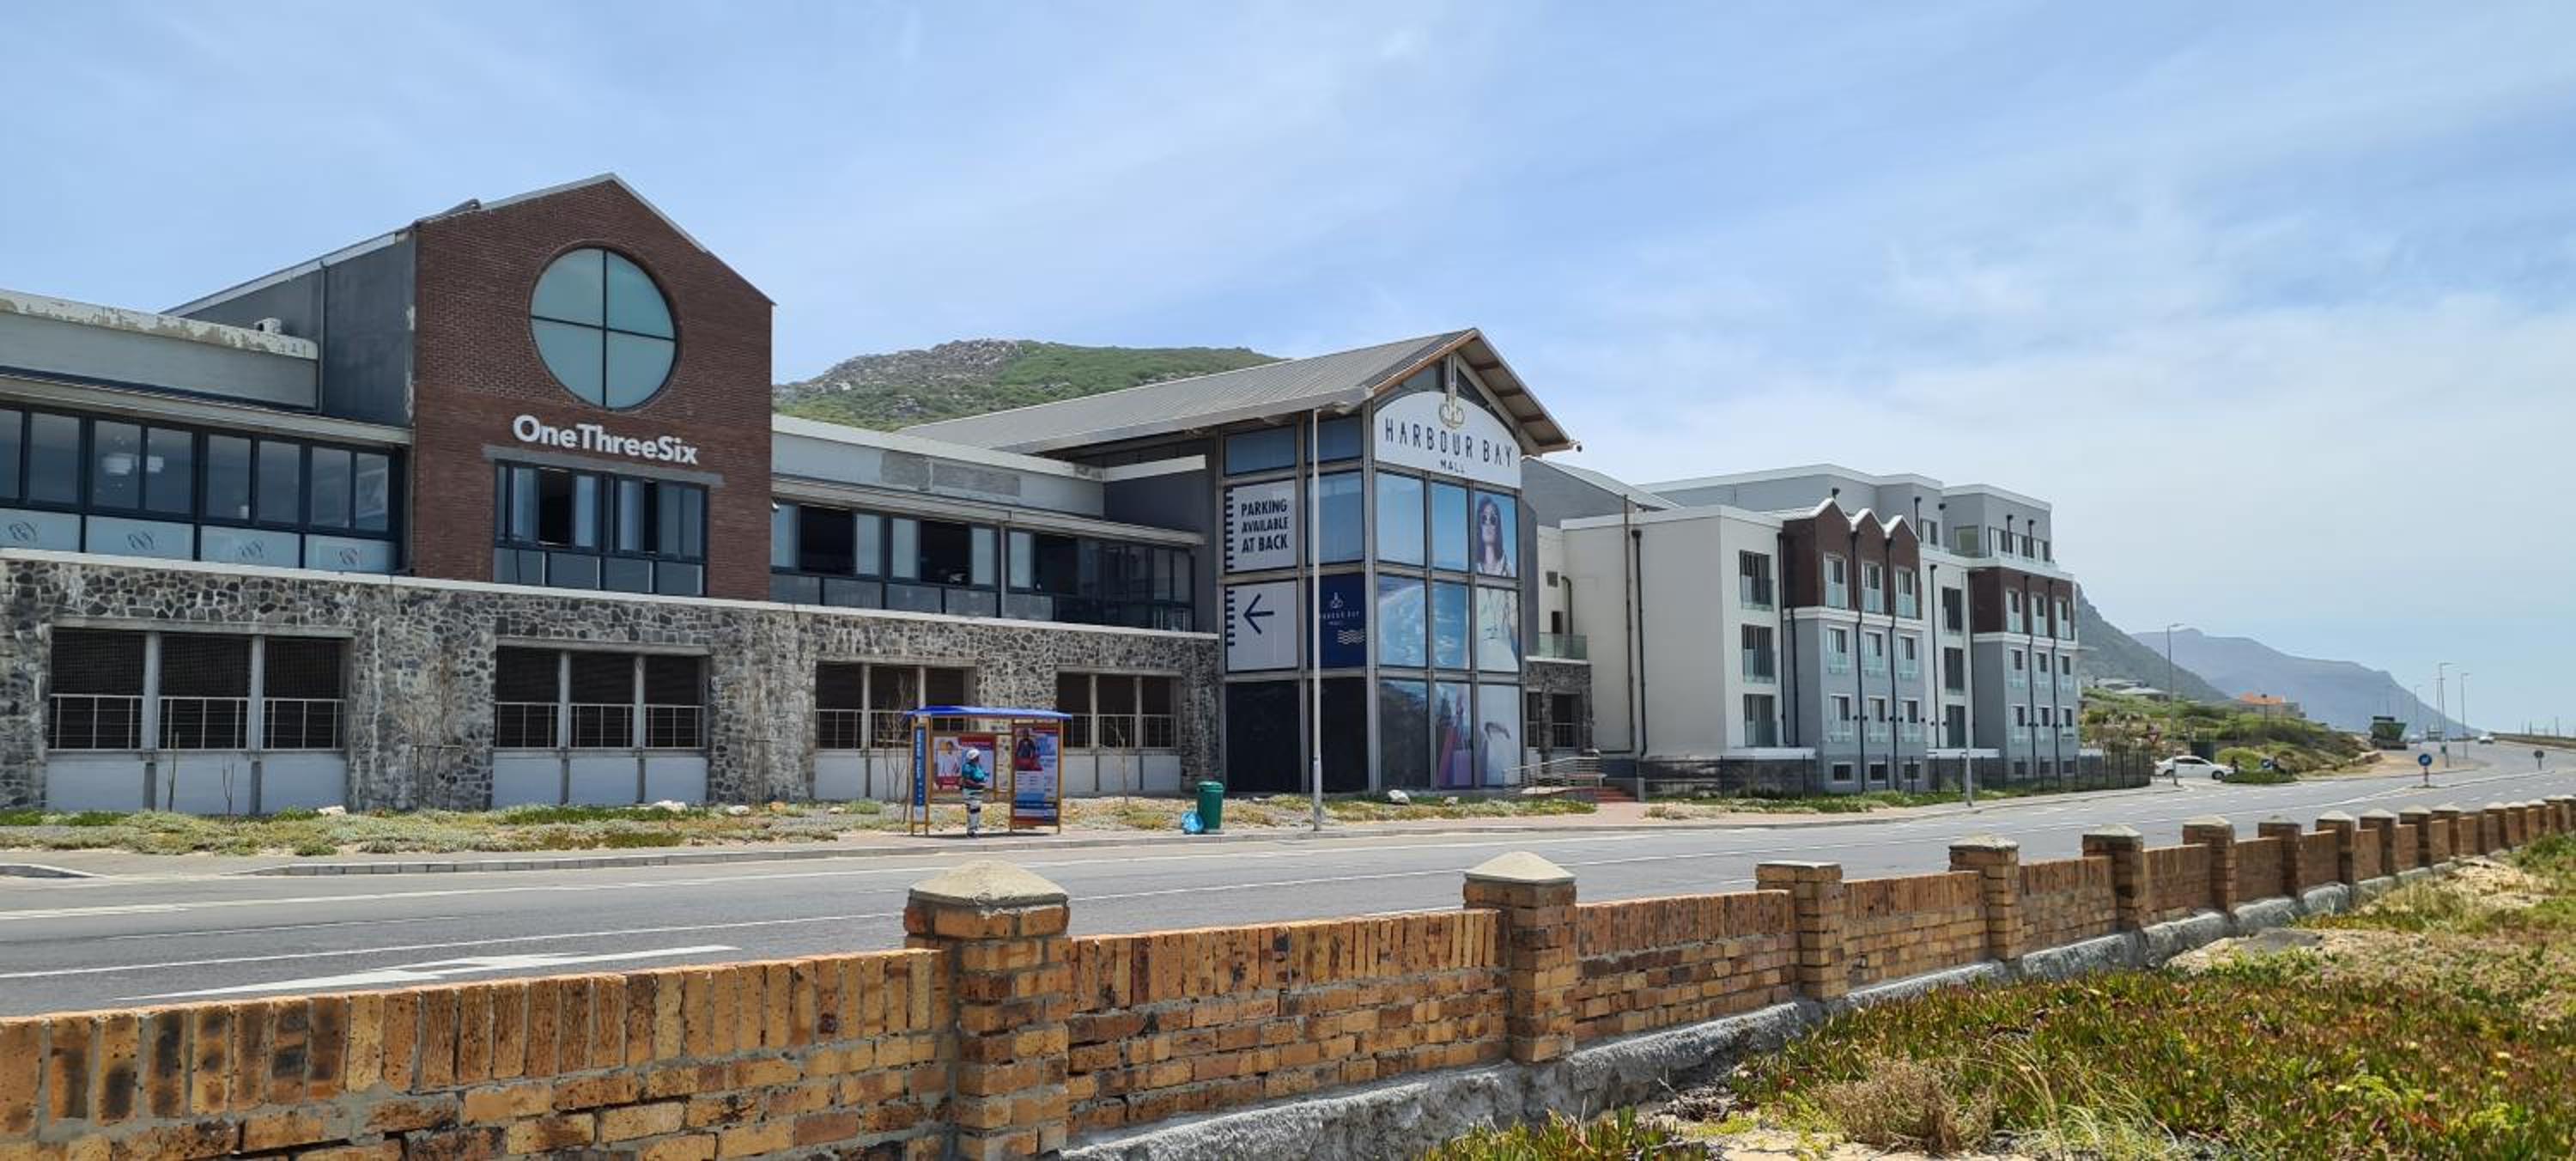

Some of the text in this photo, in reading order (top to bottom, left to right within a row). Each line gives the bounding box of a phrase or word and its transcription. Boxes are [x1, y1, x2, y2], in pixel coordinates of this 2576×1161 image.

[513, 415, 698, 465] OneThreeSix
[1385, 417, 1512, 468] HARBOUR BAY
[1440, 459, 1465, 473] MALL
[1241, 499, 1288, 517] PARKING
[1242, 517, 1288, 533] AVAILABLE
[1242, 534, 1288, 553] AT BACK
